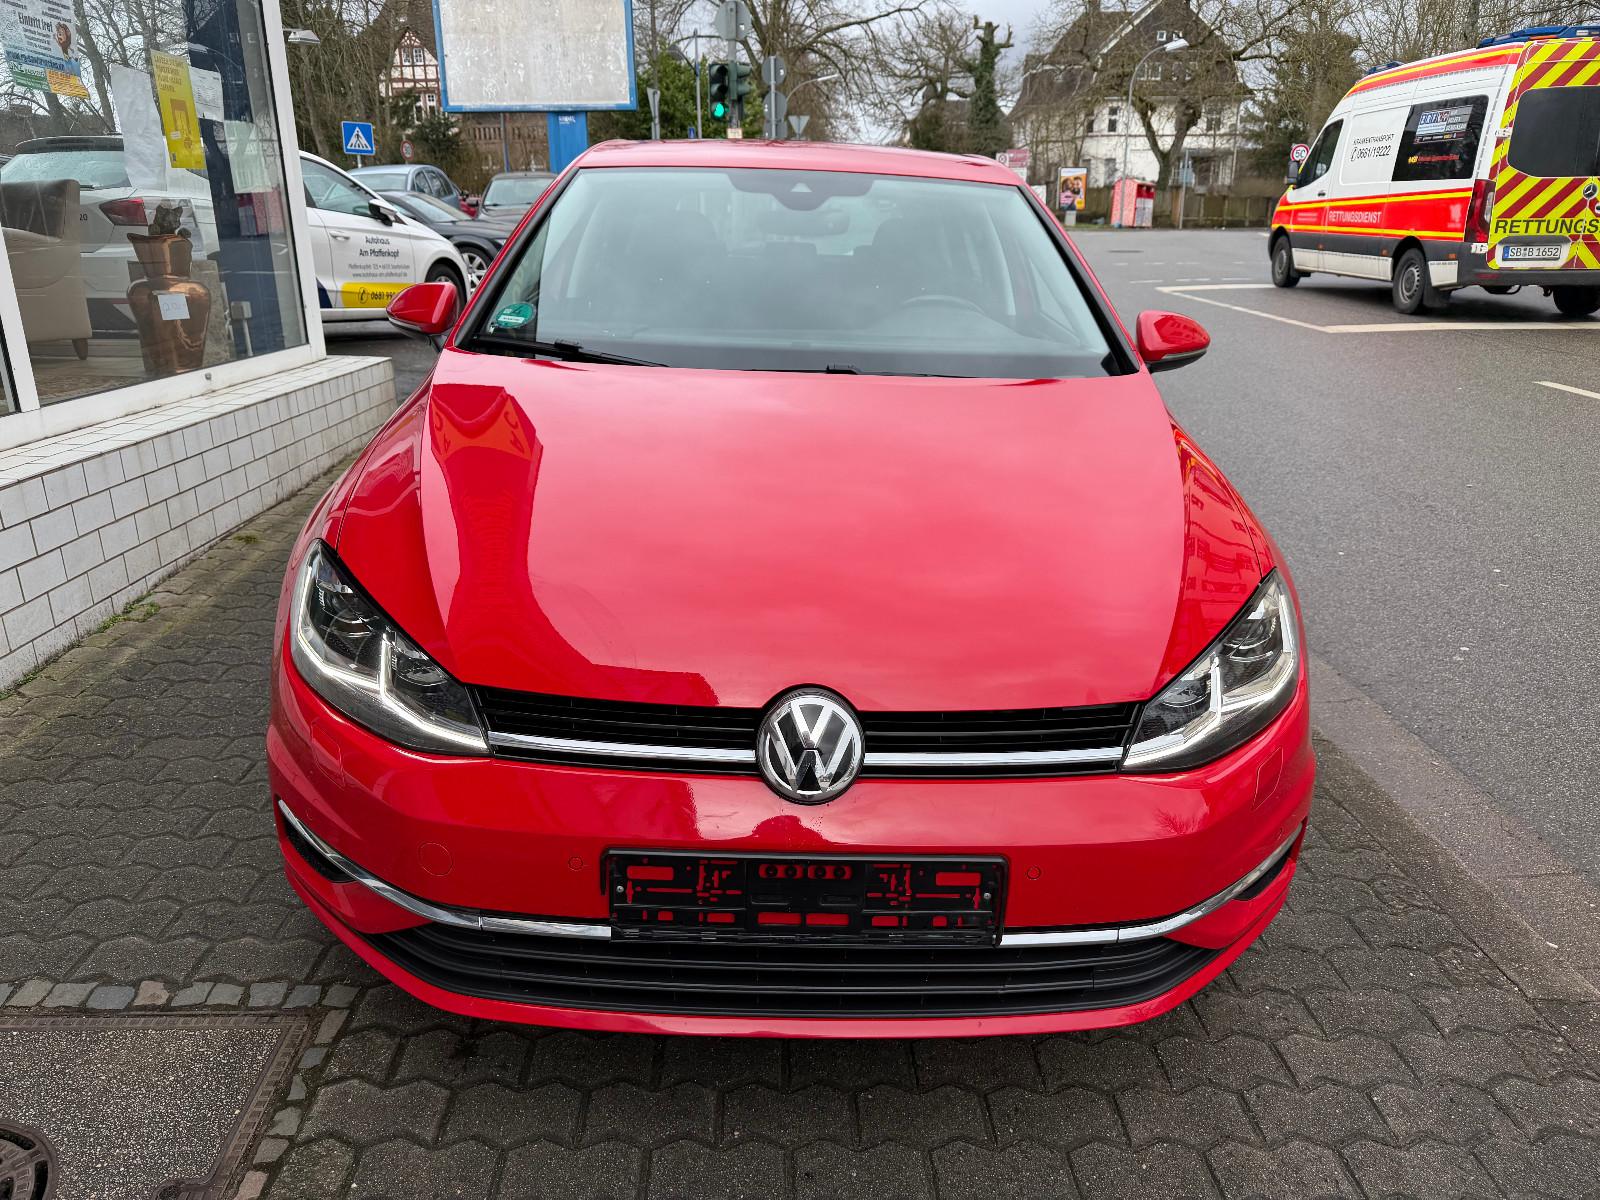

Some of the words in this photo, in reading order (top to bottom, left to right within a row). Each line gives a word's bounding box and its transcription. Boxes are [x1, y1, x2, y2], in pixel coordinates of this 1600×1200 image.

[1328, 210, 1383, 224] RETTUNGSDIENST
[1494, 218, 1600, 234] RETTUNGS
[365, 236, 391, 245] Autohaus
[359, 248, 369, 258] Am
[370, 248, 400, 260] Pfaffenkopf
[1509, 247, 1522, 257] SB
[1527, 248, 1534, 257] B
[1535, 247, 1560, 257] 1652
[370, 291, 385, 301] 0681
